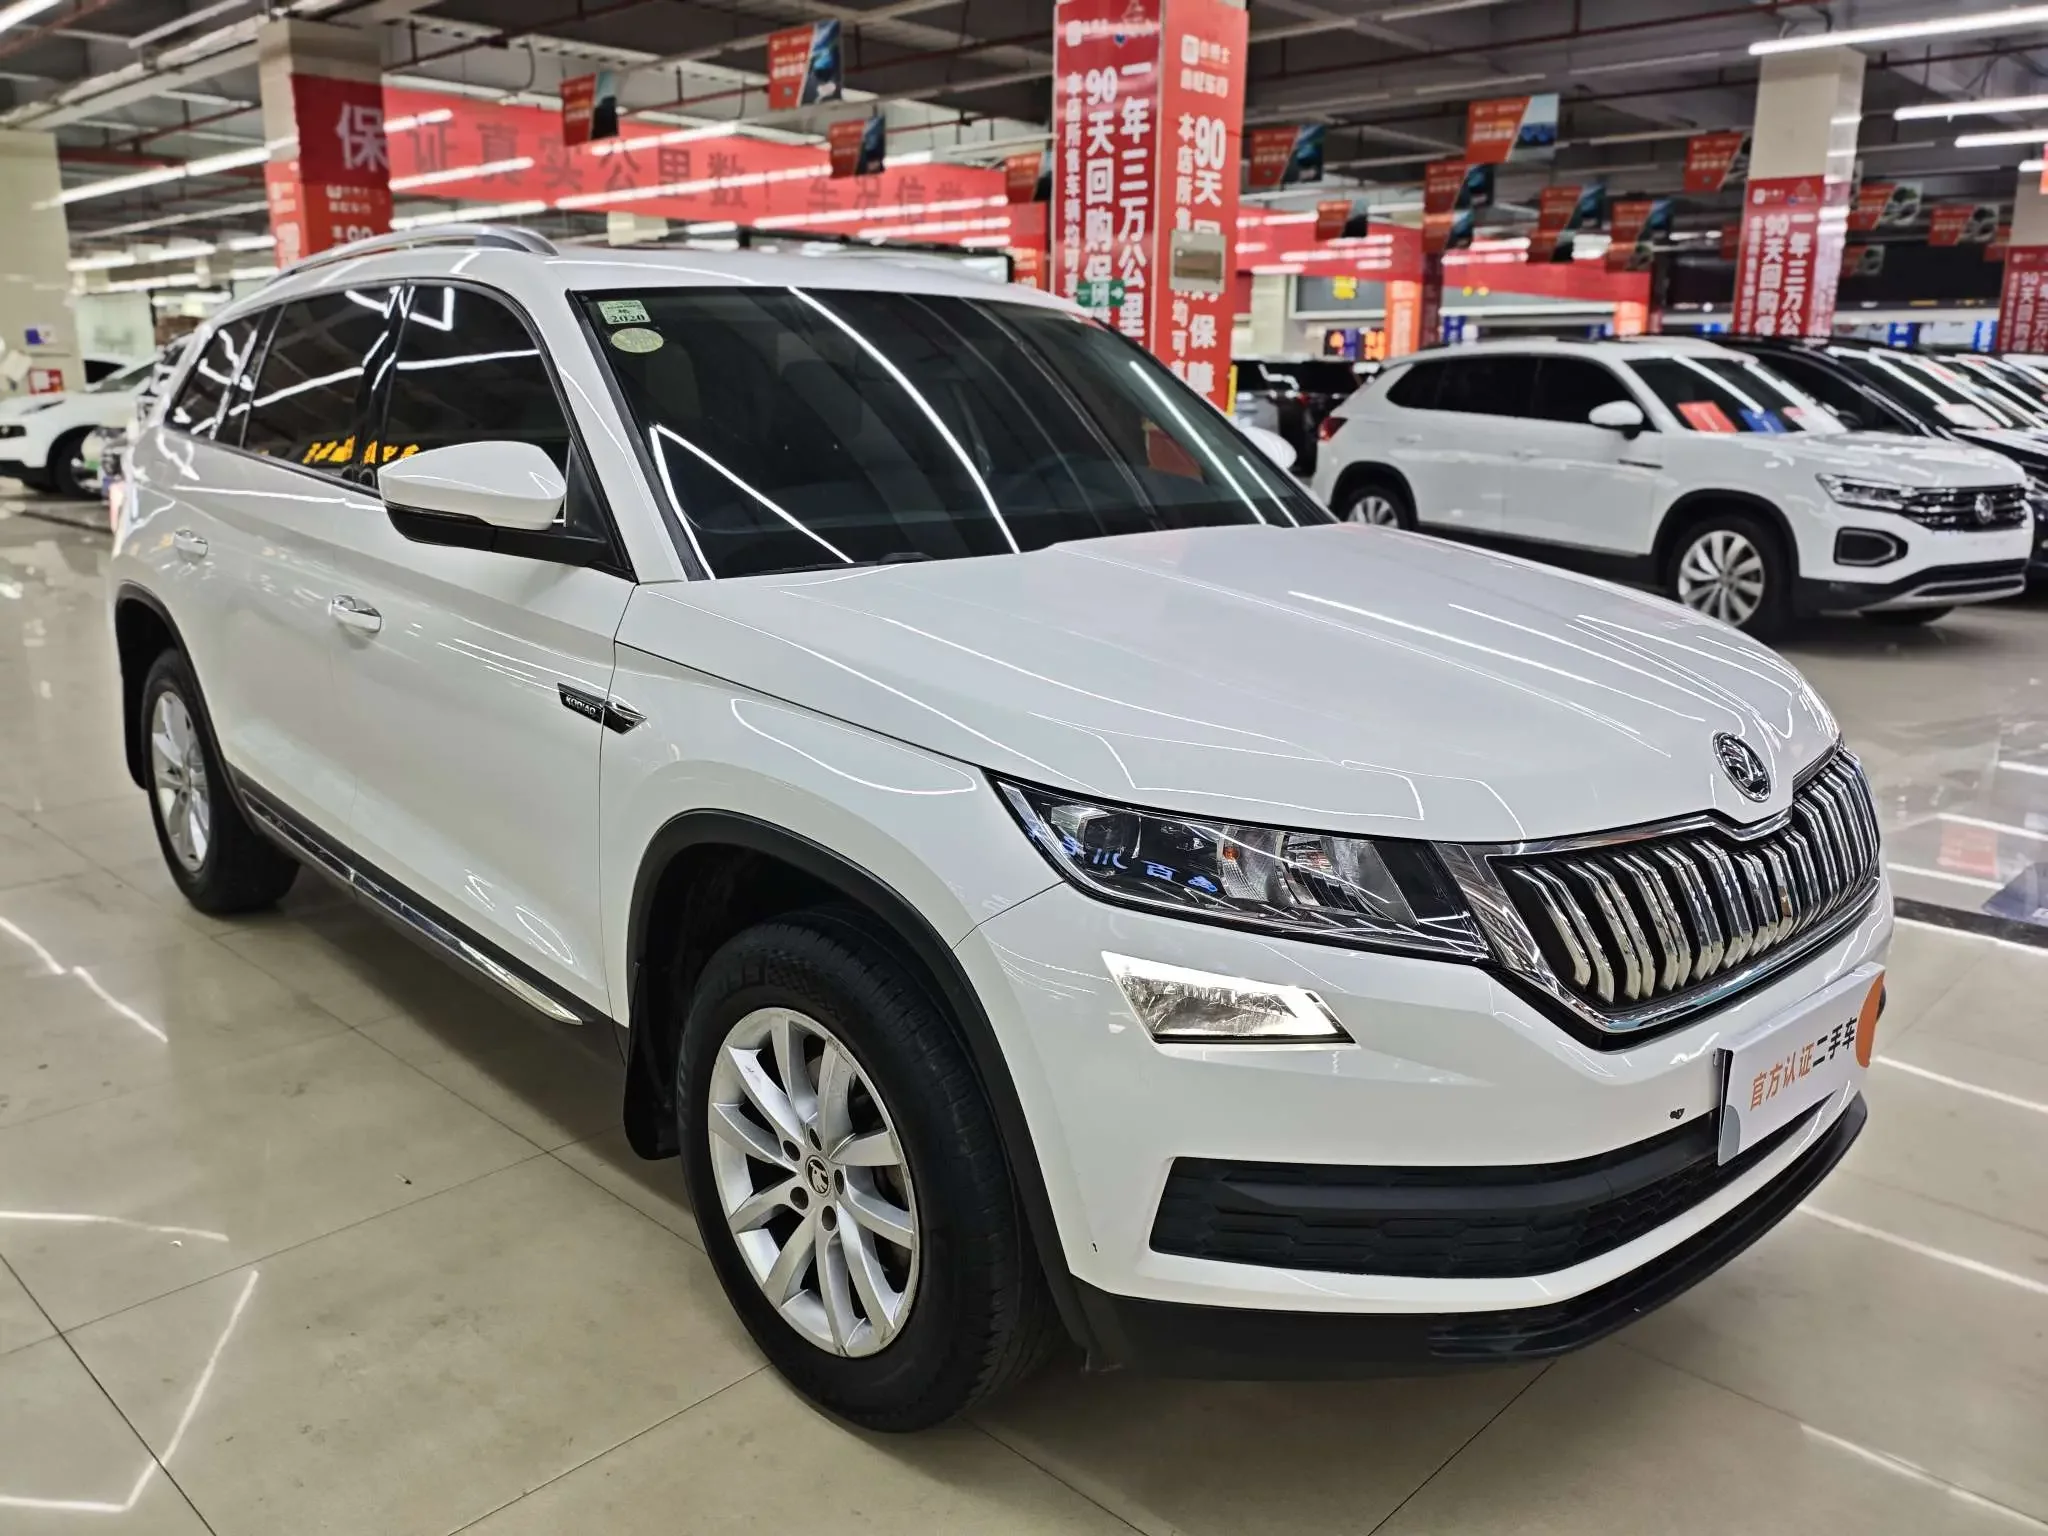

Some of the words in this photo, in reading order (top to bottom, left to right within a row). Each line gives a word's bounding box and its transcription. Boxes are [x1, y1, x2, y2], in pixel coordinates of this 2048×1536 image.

[1118, 61, 1152, 347] 一年三万公里
[610, 314, 646, 323] 2020
[1750, 1016, 1857, 1111] 官方认证二手车
